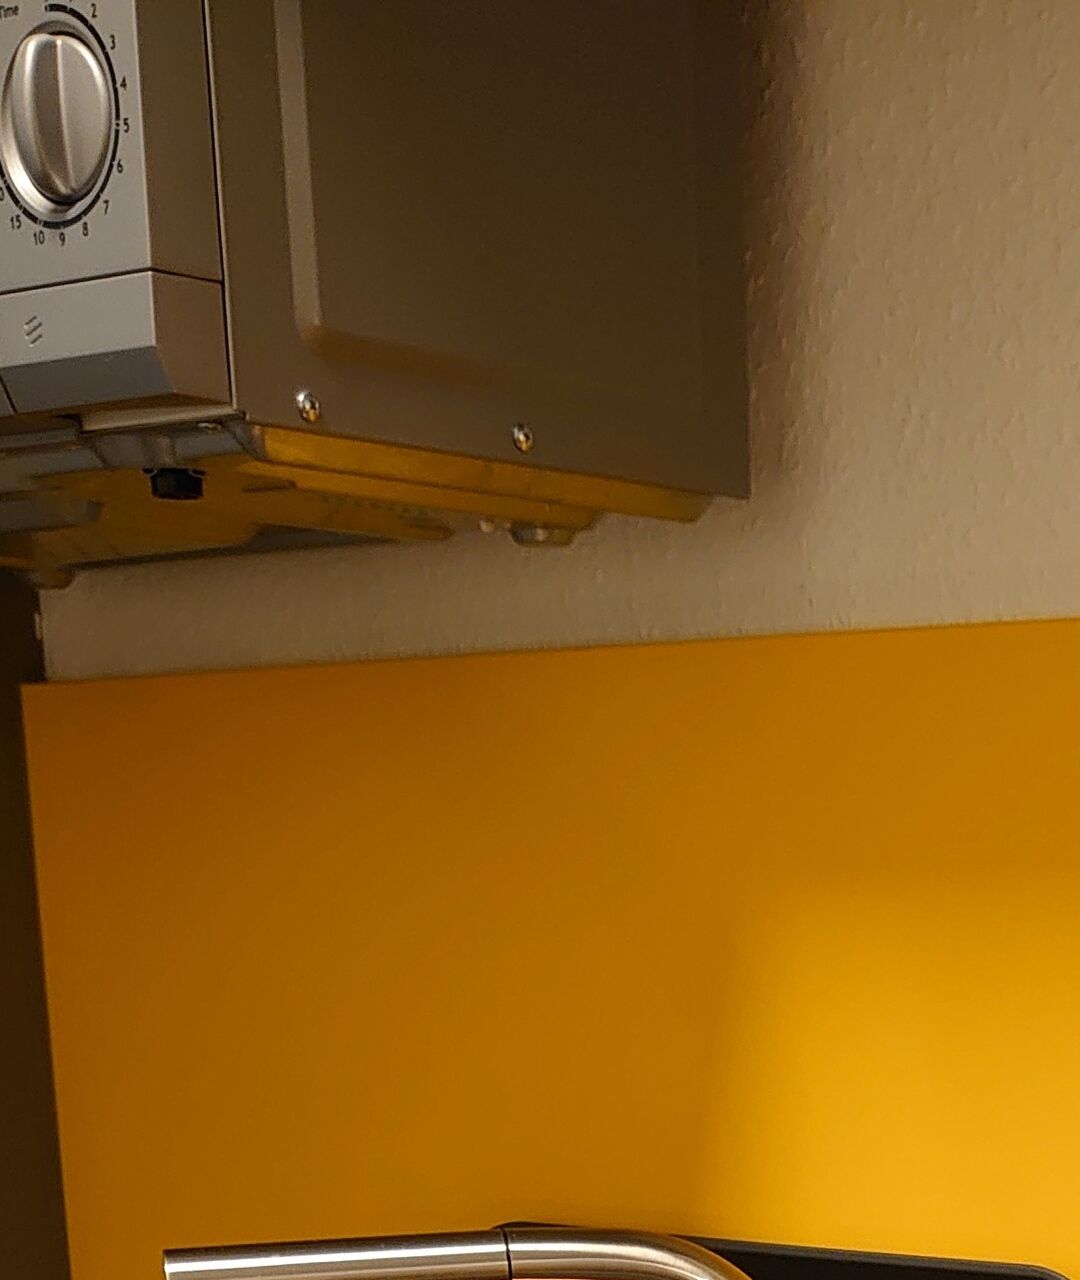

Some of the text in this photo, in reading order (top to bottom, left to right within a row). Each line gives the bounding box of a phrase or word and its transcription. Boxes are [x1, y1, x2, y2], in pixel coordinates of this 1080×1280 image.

[91, 4, 98, 18] 2
[109, 34, 117, 50] 3
[120, 75, 127, 91] 4
[123, 118, 130, 133] 5
[116, 159, 124, 174] 6
[103, 200, 109, 215] 7
[10, 217, 21, 230] 15
[82, 222, 89, 237] 8
[33, 230, 45, 246] 10
[59, 232, 66, 247] 9
